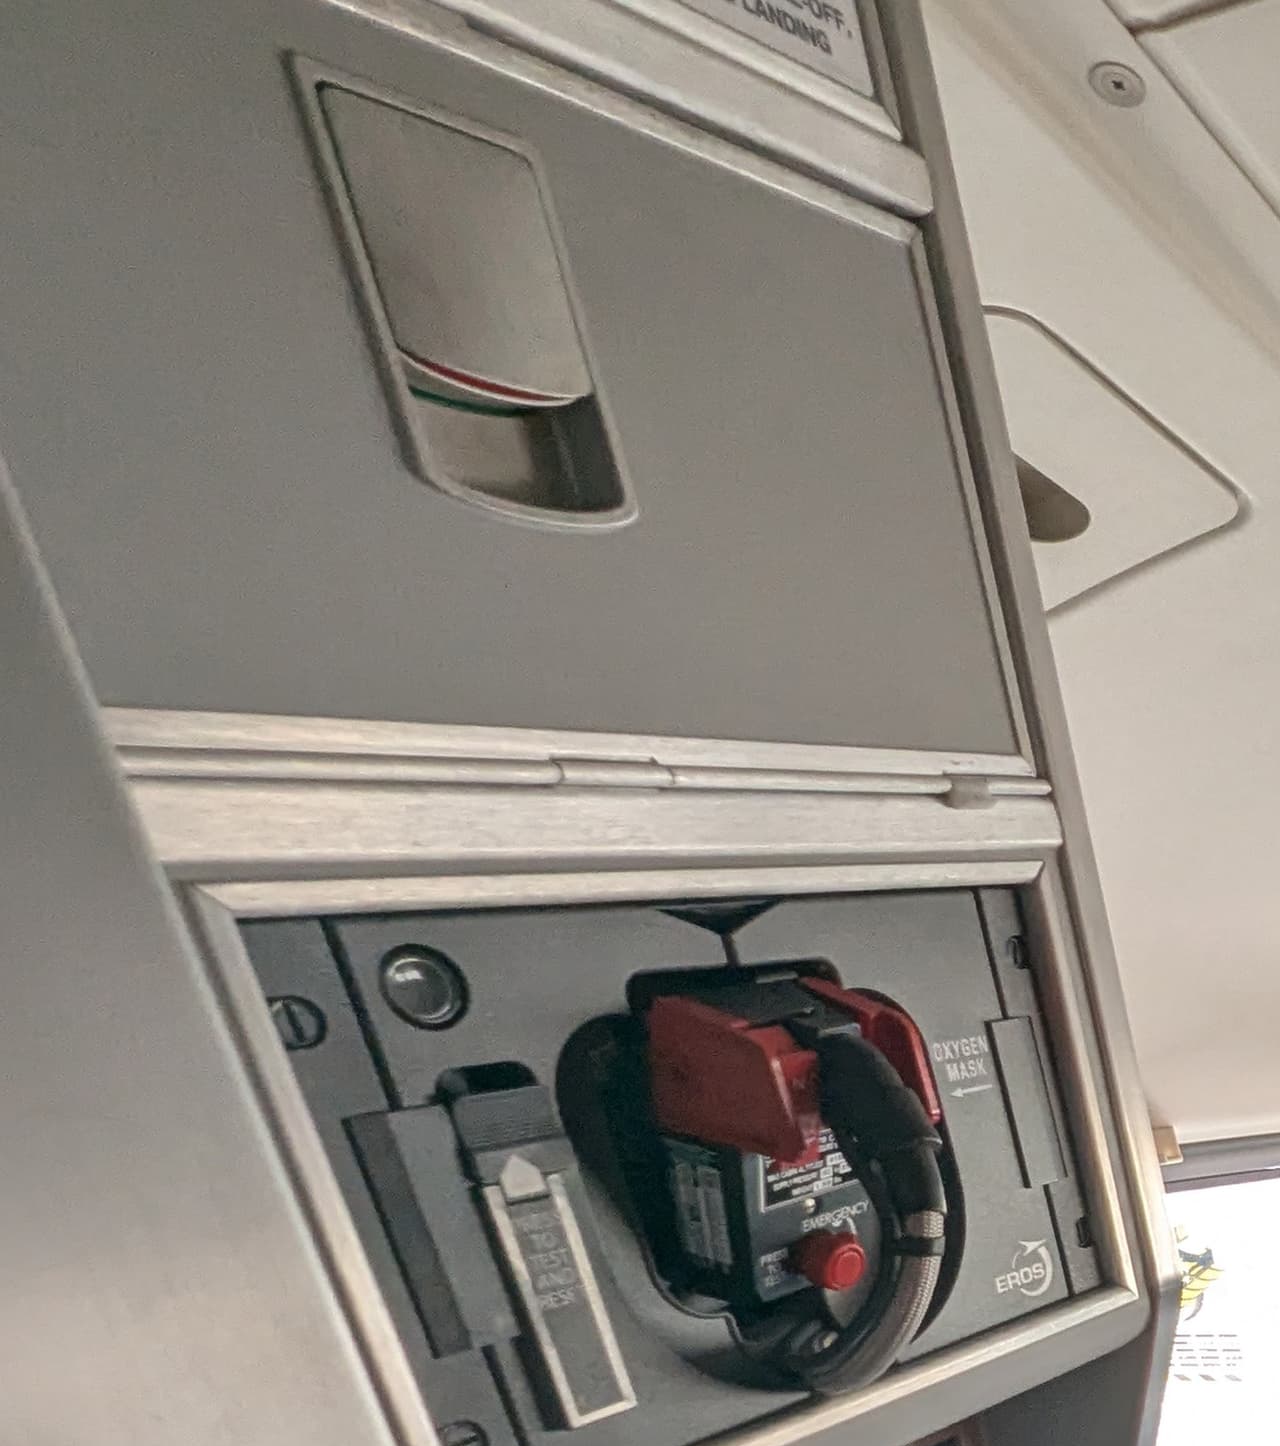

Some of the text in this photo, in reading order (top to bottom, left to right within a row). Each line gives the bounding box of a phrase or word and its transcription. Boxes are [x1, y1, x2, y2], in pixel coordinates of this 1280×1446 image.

[932, 1035, 989, 1062] OXYGEN
[945, 1058, 989, 1082] MASK
[801, 1199, 870, 1233] EMERGENCY
[994, 1262, 1046, 1294] EROS
